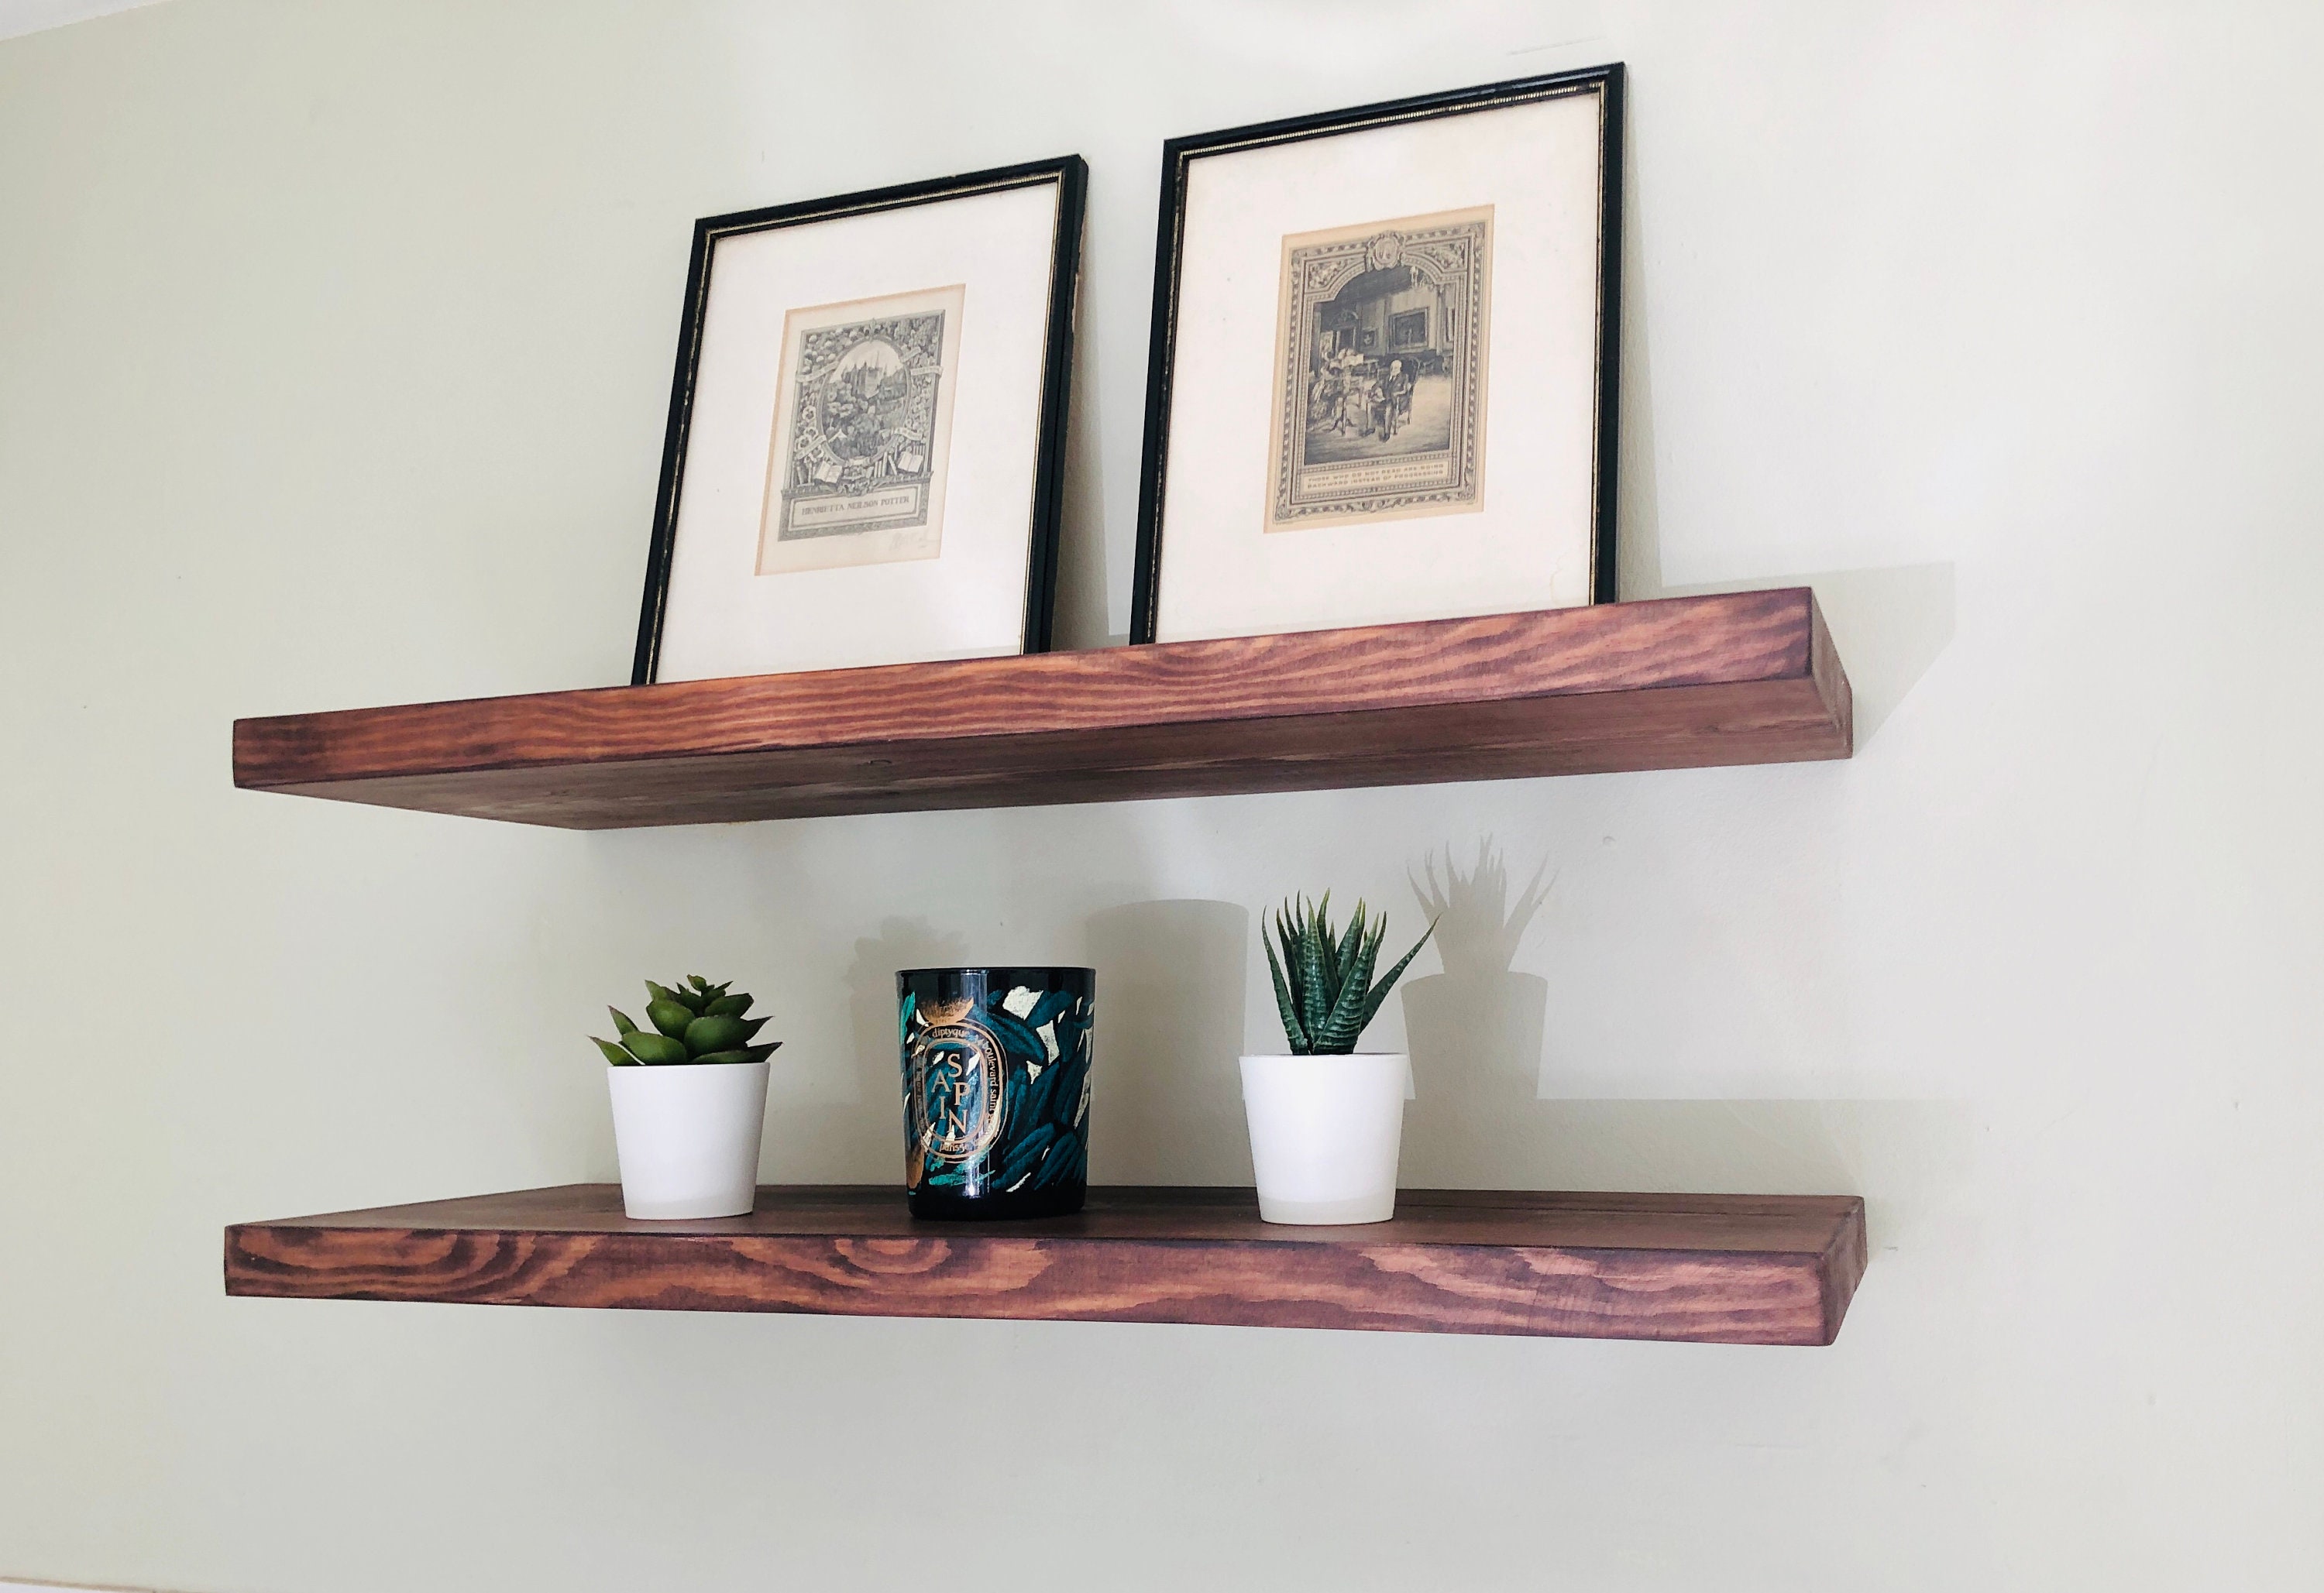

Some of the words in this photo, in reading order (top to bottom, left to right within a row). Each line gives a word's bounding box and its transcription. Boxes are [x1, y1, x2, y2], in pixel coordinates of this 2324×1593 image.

[802, 504, 844, 515] HENRIETTA
[847, 500, 878, 510] NEILSON
[880, 496, 909, 506] POTTER
